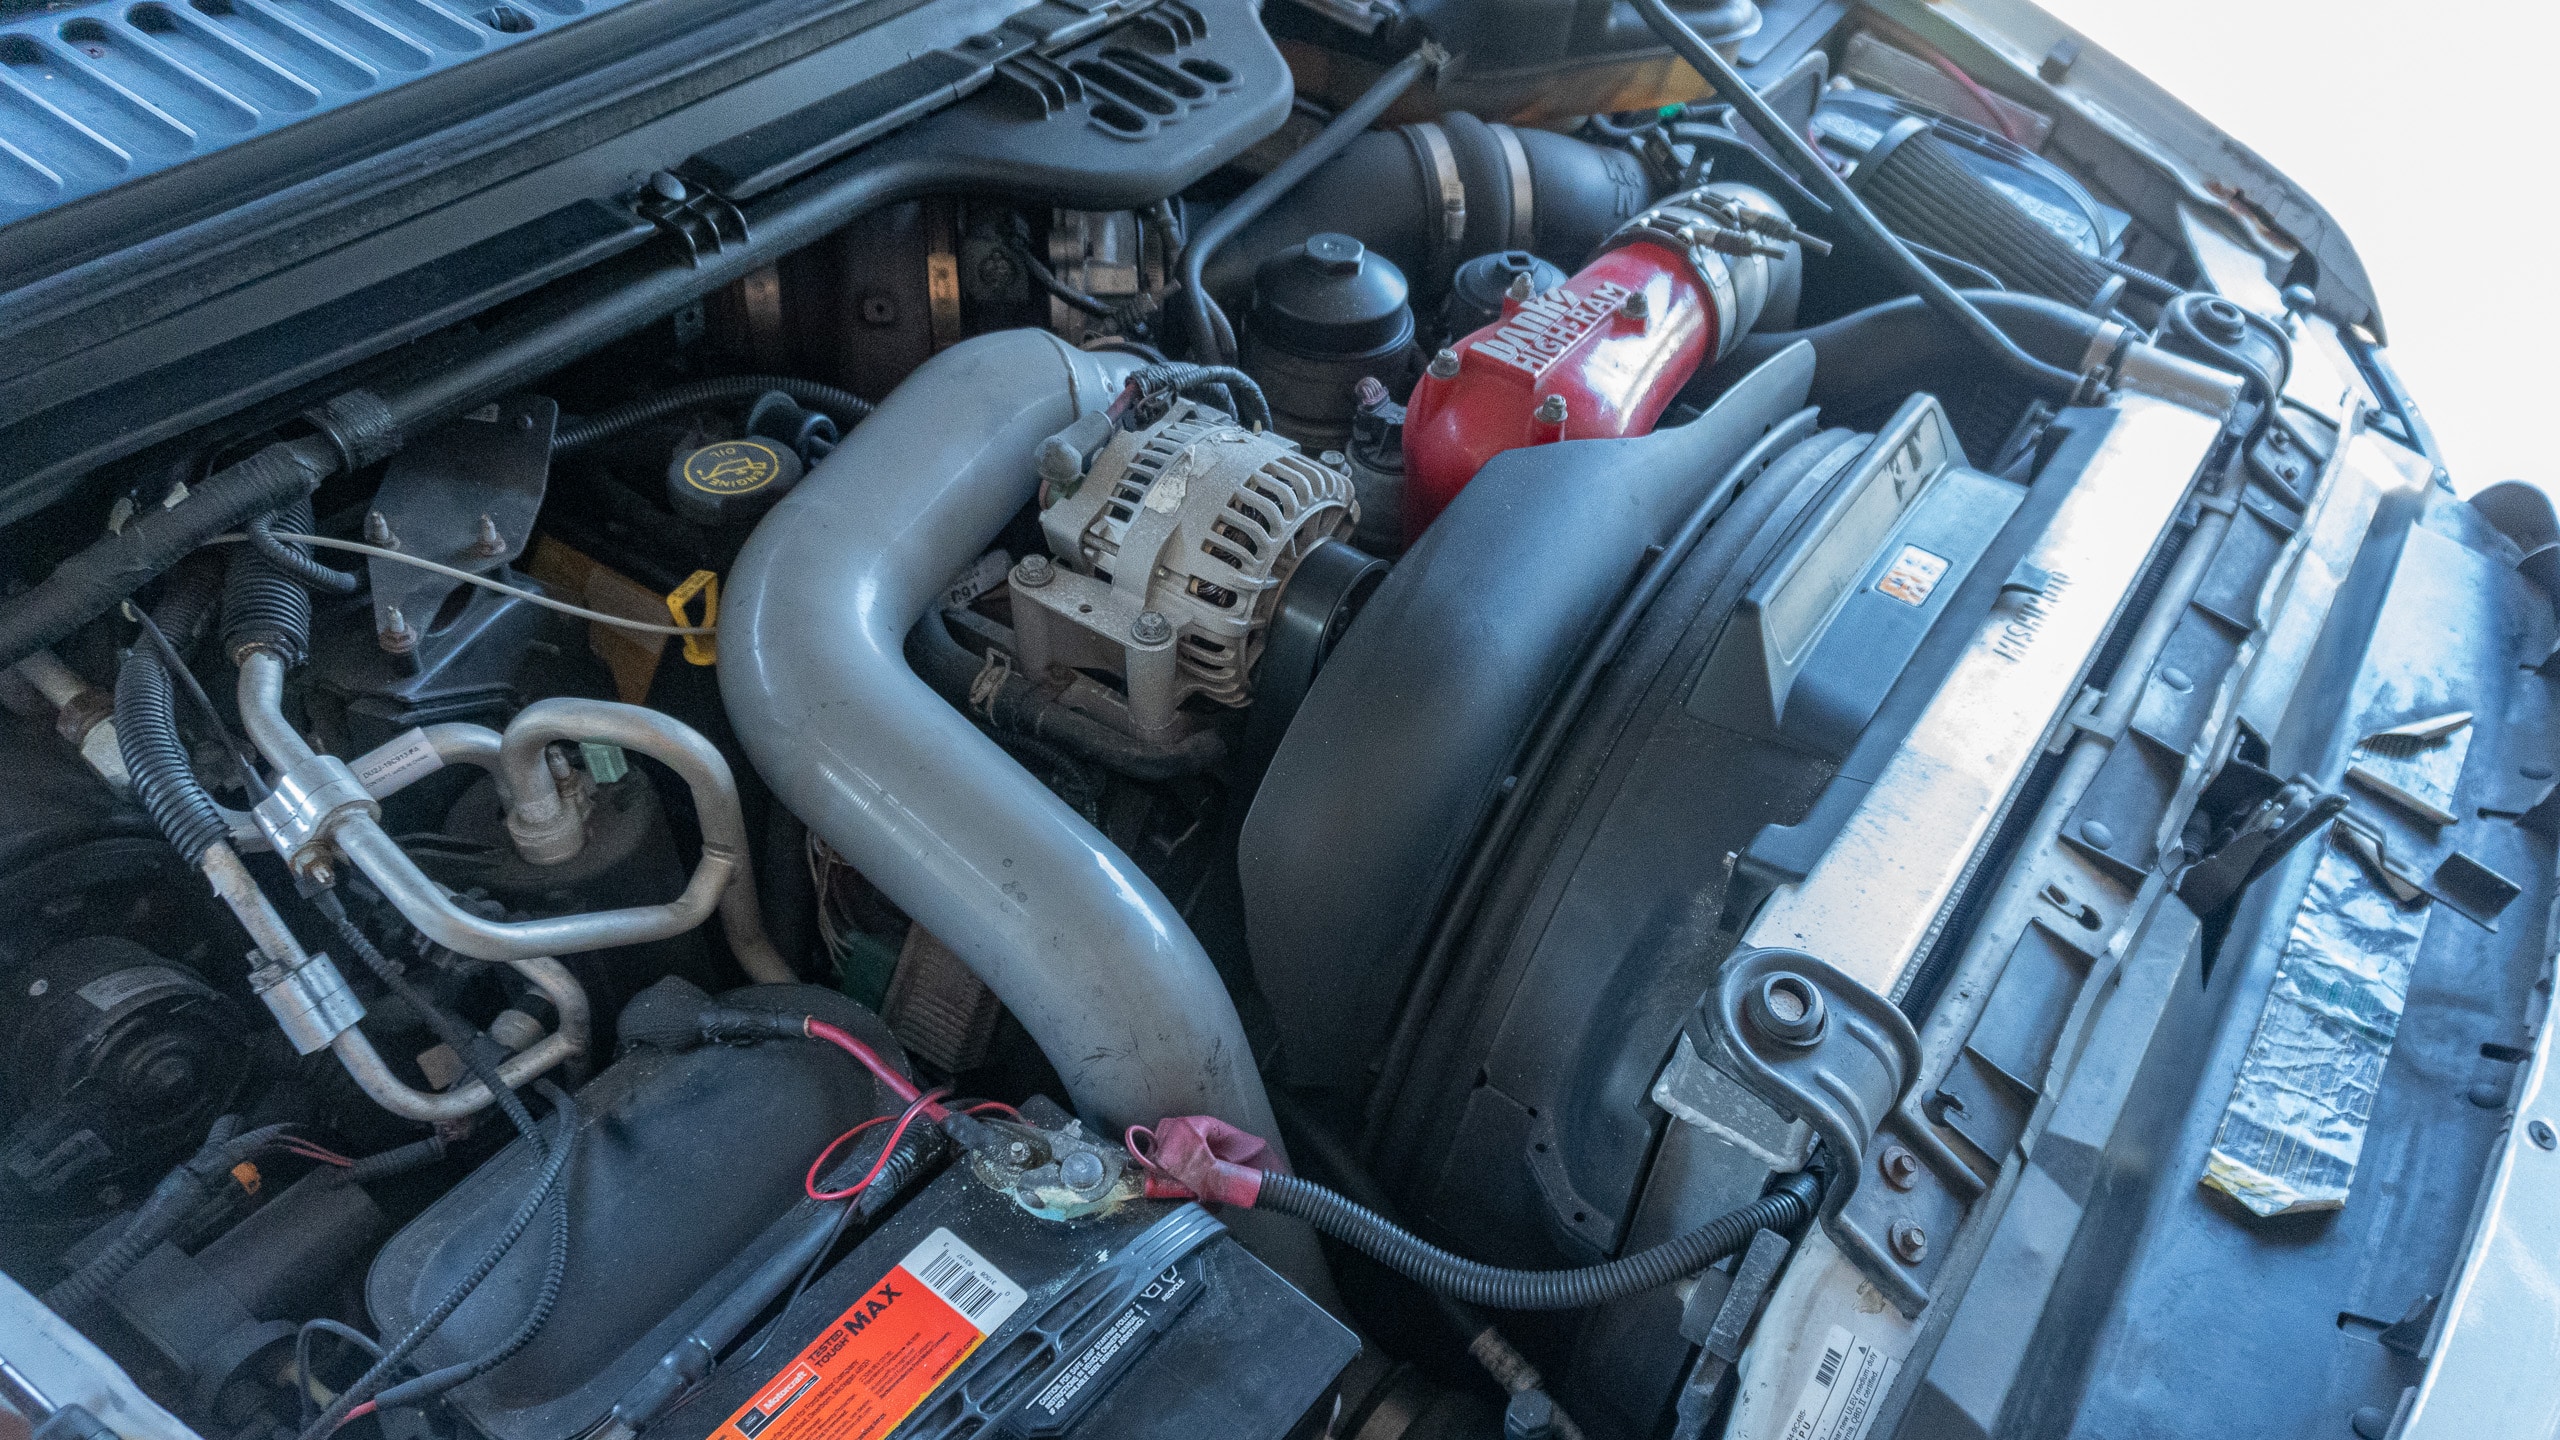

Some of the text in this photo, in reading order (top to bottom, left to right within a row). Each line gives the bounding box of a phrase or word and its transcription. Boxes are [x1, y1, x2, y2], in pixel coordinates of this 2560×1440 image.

[1509, 280, 1632, 377] HIGH-RAM
[709, 447, 736, 457] OIL
[707, 470, 765, 488] ENGINE
[842, 1282, 903, 1337] MAX
[1161, 1277, 1186, 1303] RECYCLE
[806, 1328, 845, 1364] TESTED
[929, 1334, 980, 1382] motorcraft.com
[1059, 1372, 1072, 1386] FOR
[1069, 1360, 1084, 1375] SAFE
[1081, 1347, 1097, 1363] JUMP
[1093, 1326, 1118, 1351] STARTING
[1115, 1307, 1136, 1329] FOLLOW
[762, 1368, 809, 1412] Motorcraft
[804, 1395, 820, 1411] Ford
[817, 1380, 836, 1399] Motor
[1044, 1375, 1079, 1411] INSTRUCTIONS
[1076, 1369, 1085, 1378] IN
[1082, 1351, 1103, 1372] VEHICLE
[1048, 1406, 1058, 1416] IF
[1054, 1397, 1068, 1411] NOT
[1065, 1373, 1091, 1400] AVAILABLE
[1087, 1362, 1103, 1377] SEEK
[1099, 1343, 1121, 1365] SERVICE
[1839, 1416, 1850, 1431] new
[1845, 1394, 1859, 1416] ULEV
[1854, 1351, 1878, 1395] medium-duty
[1861, 1369, 1880, 1399] certified.
